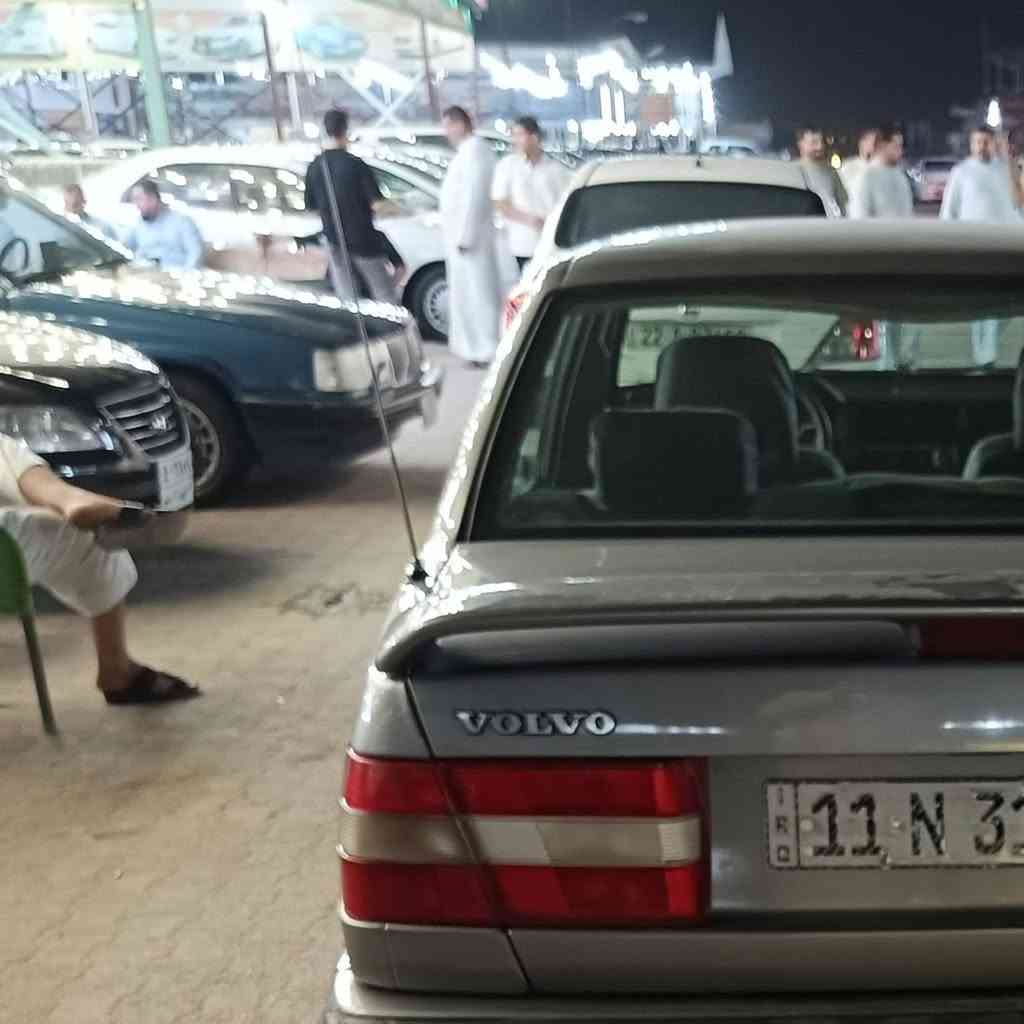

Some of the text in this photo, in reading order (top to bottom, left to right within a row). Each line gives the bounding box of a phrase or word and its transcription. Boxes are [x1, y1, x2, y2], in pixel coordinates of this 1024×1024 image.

[455, 711, 616, 736] VOLVO
[775, 786, 790, 862] IRQ
[811, 793, 882, 857] 11
[910, 790, 946, 856] N
